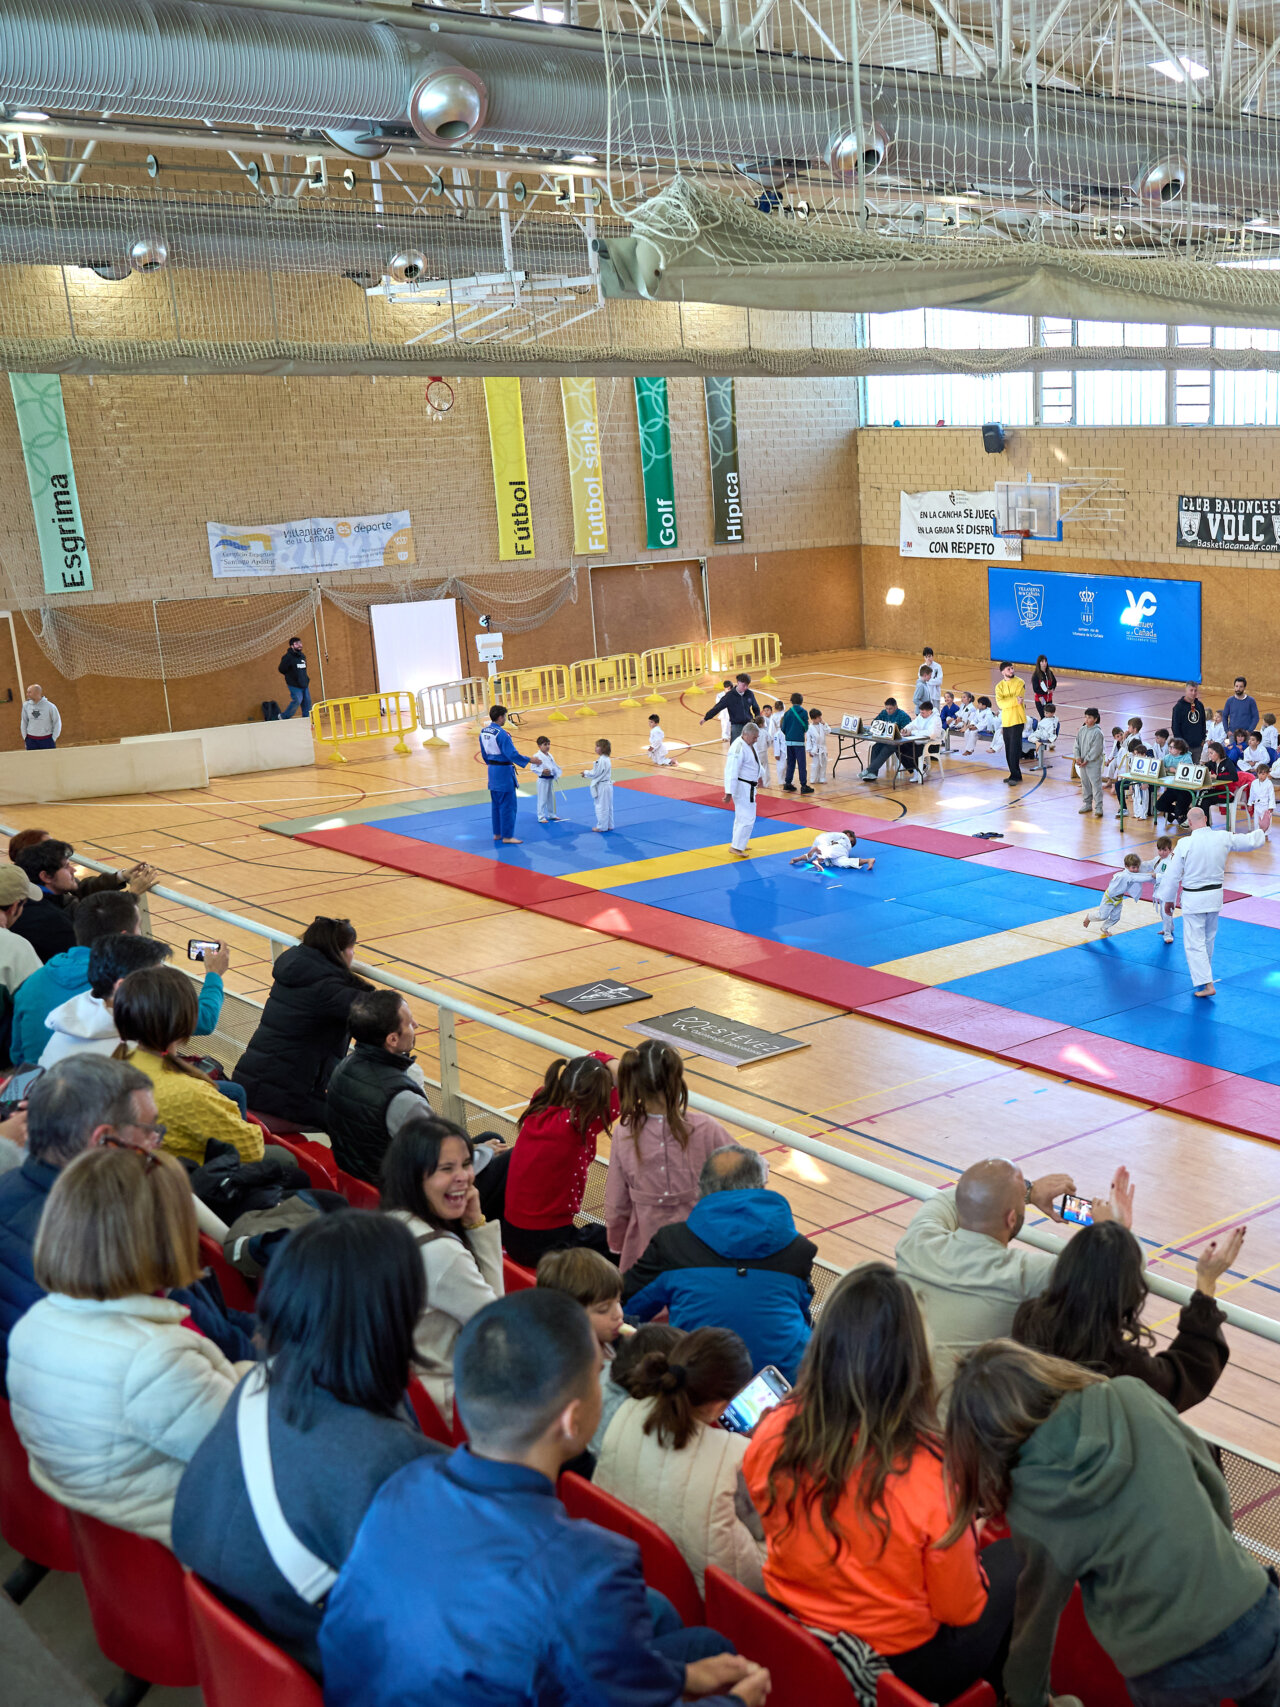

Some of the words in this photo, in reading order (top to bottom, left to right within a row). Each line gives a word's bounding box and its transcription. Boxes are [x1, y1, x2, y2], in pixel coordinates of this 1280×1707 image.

[580, 422, 598, 470] sala
[724, 472, 743, 541] Hípica
[1182, 497, 1210, 511] CLUB
[509, 481, 532, 556] Fútbol
[584, 478, 606, 550] Fútbol
[938, 510, 962, 519] CANCHA
[964, 508, 974, 518] SE
[974, 510, 996, 520] JUEG
[656, 498, 676, 546] Golf
[956, 524, 964, 534] SE
[51, 474, 86, 588] Esgrima
[284, 528, 334, 538] Villanueva
[338, 525, 350, 534] es
[354, 522, 392, 534] deporte
[929, 542, 948, 554] CON
[951, 542, 995, 555] RESPETO
[1197, 539, 1278, 551] Basketlacanada.com
[873, 721, 884, 731] 20
[888, 726, 893, 734] 0
[1137, 759, 1144, 770] 0
[1151, 762, 1157, 772] 0
[1182, 767, 1189, 777] 0
[1196, 769, 1203, 779] 0
